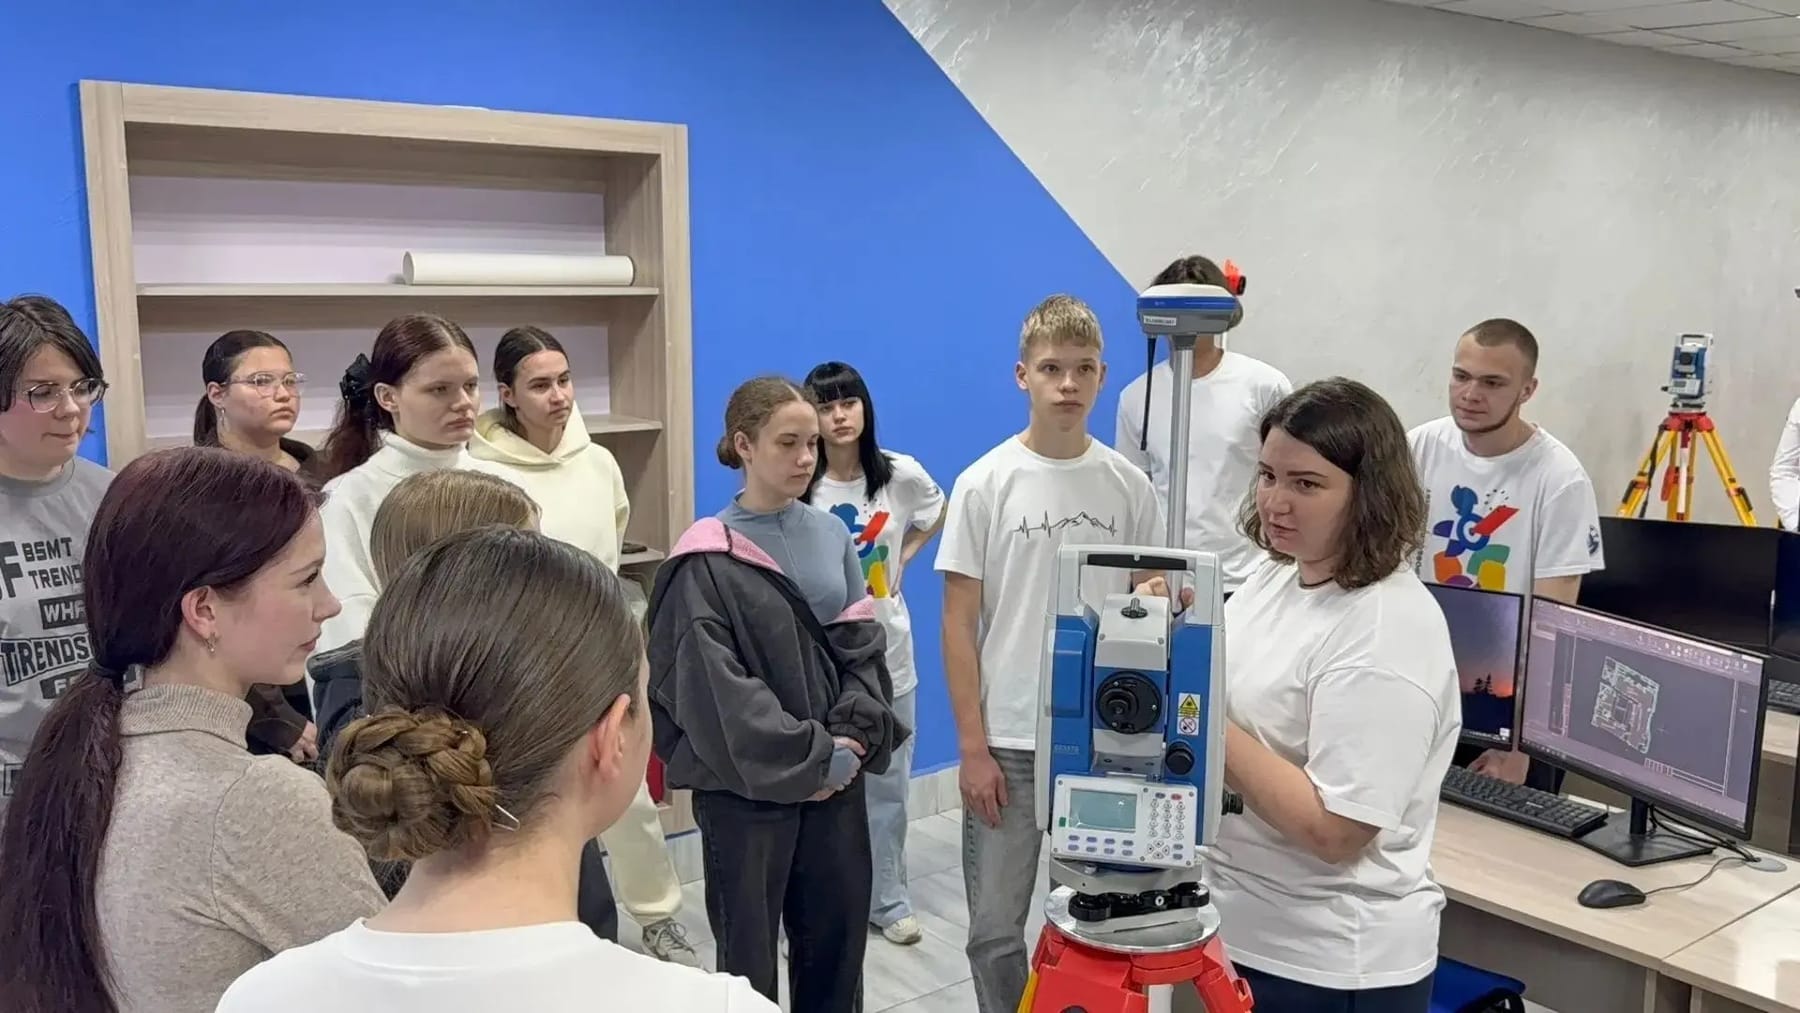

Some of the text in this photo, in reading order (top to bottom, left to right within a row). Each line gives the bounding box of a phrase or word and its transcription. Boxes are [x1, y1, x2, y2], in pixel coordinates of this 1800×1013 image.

[0, 541, 23, 599] F
[22, 537, 72, 562] BSMT
[1, 636, 91, 682] TRENDS
